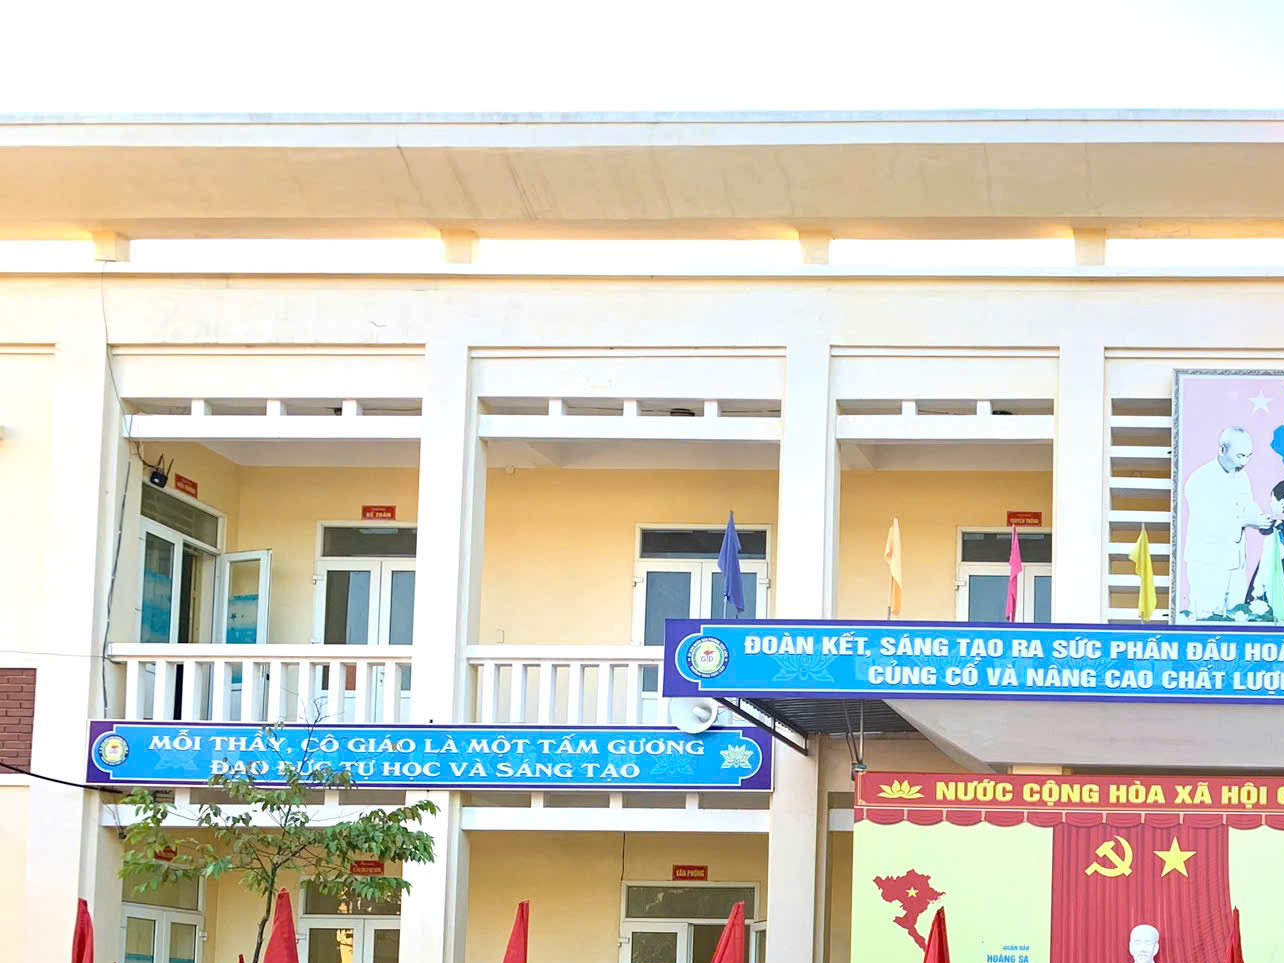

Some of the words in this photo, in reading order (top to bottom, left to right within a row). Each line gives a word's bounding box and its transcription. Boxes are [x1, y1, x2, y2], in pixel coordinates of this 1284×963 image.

[744, 633, 814, 656] ĐOÀN
[821, 632, 871, 657] KẾT,
[880, 634, 949, 657] SÁNG
[957, 638, 1004, 661] TẠO
[1012, 639, 1044, 657] RA
[1053, 637, 1102, 658] SỨC
[1110, 636, 1178, 660] PHẤN
[1186, 637, 1236, 661] ĐẤU
[945, 657, 981, 686] CỐ
[987, 664, 1018, 686] VÀ
[1027, 666, 1096, 688] NÂNG
[1105, 670, 1152, 689] CAO
[1161, 666, 1225, 690] CHẤT
[148, 729, 201, 751] MỖI
[208, 731, 293, 754] THẦY,
[301, 734, 339, 753] CÔ
[346, 735, 416, 753] GIÁO
[424, 735, 459, 754] LÀ
[468, 735, 530, 757] MỘT
[537, 734, 600, 754] TẤM
[607, 738, 705, 755] GƯƠNG
[382, 760, 441, 780] HỌC
[450, 759, 488, 777] VÀ
[496, 760, 573, 778] SÁNG
[580, 762, 641, 781] TẠO
[936, 780, 1013, 801] NƯỚC
[1023, 780, 1099, 806] CỘNG
[1109, 781, 1166, 804] HÒA
[1175, 782, 1212, 804] XÃ
[1221, 783, 1267, 808] HỘI
[1018, 955, 1029, 963] SA
